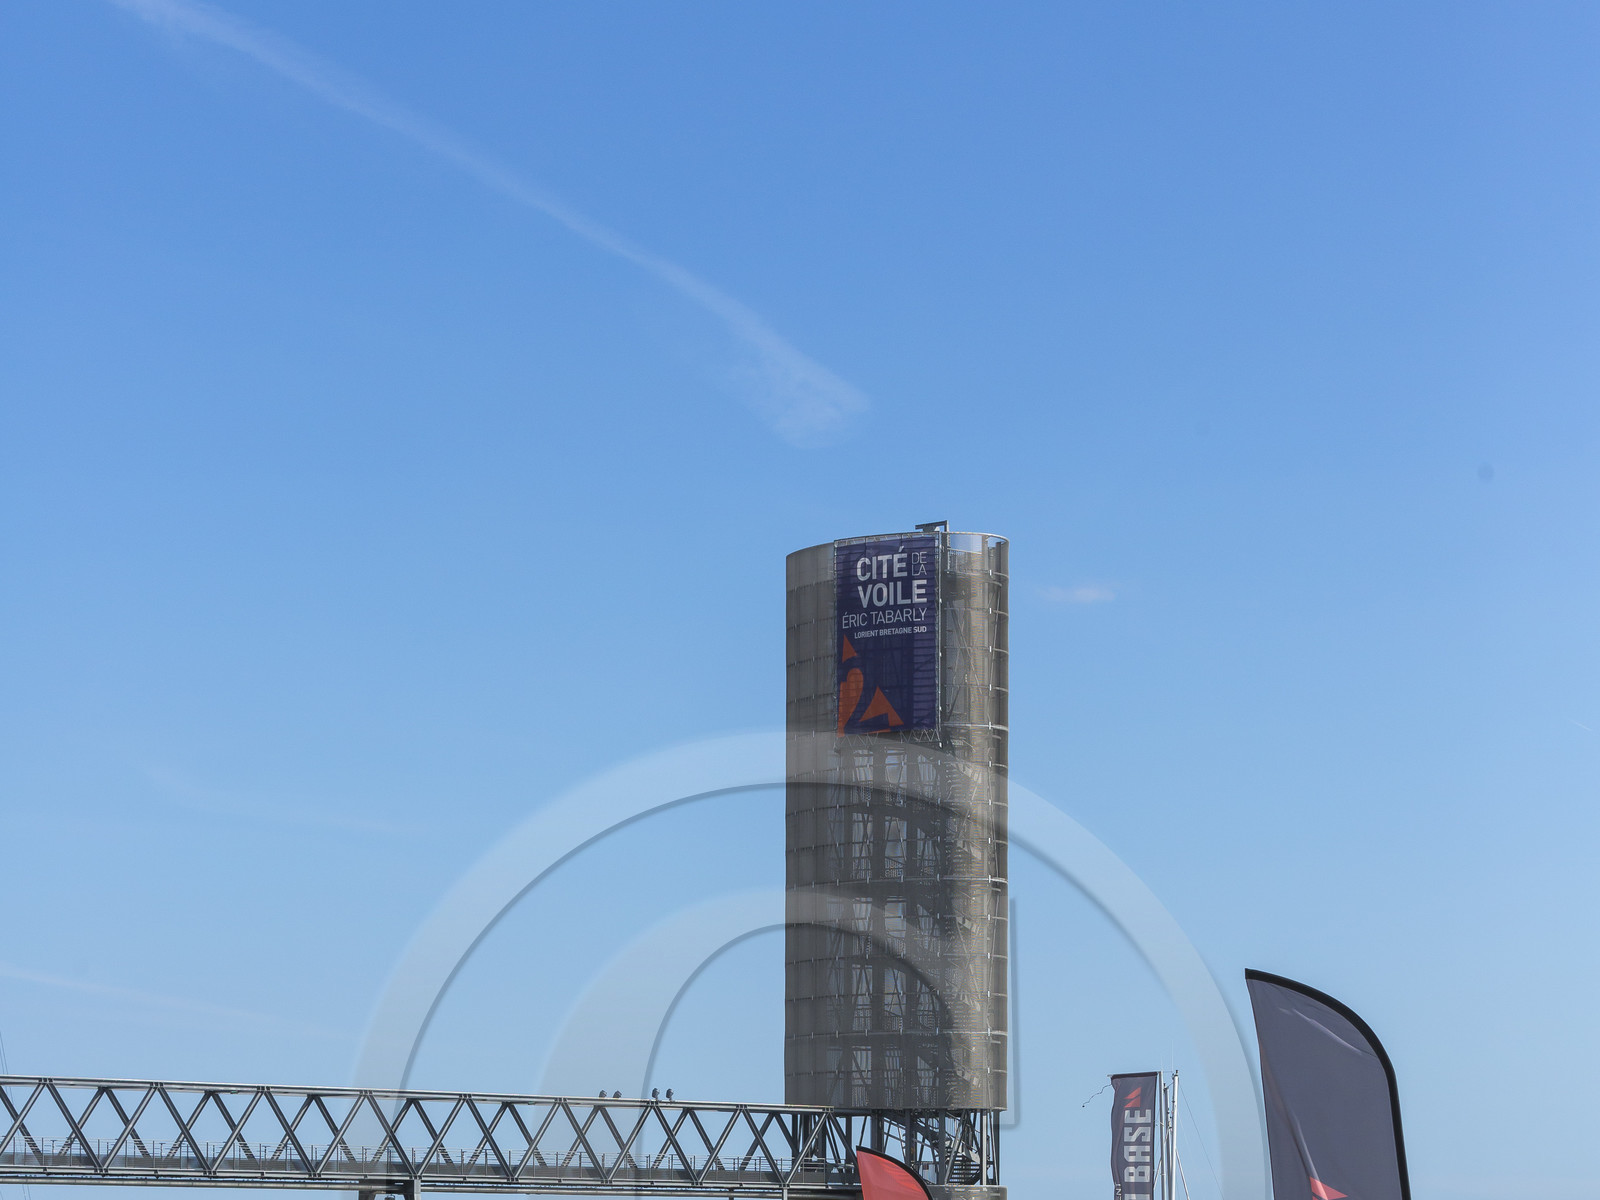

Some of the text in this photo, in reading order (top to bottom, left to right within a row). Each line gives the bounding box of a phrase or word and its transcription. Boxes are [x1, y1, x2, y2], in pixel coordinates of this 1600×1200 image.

[857, 546, 927, 581] CITÉ DE
[912, 564, 927, 576] LA
[858, 580, 927, 608] VOILE
[842, 608, 927, 629] ÉRIC TABARLY
[854, 630, 878, 639] LORIENT
[880, 627, 912, 636] BRETAGNE
[1124, 1109, 1152, 1183] BASE
